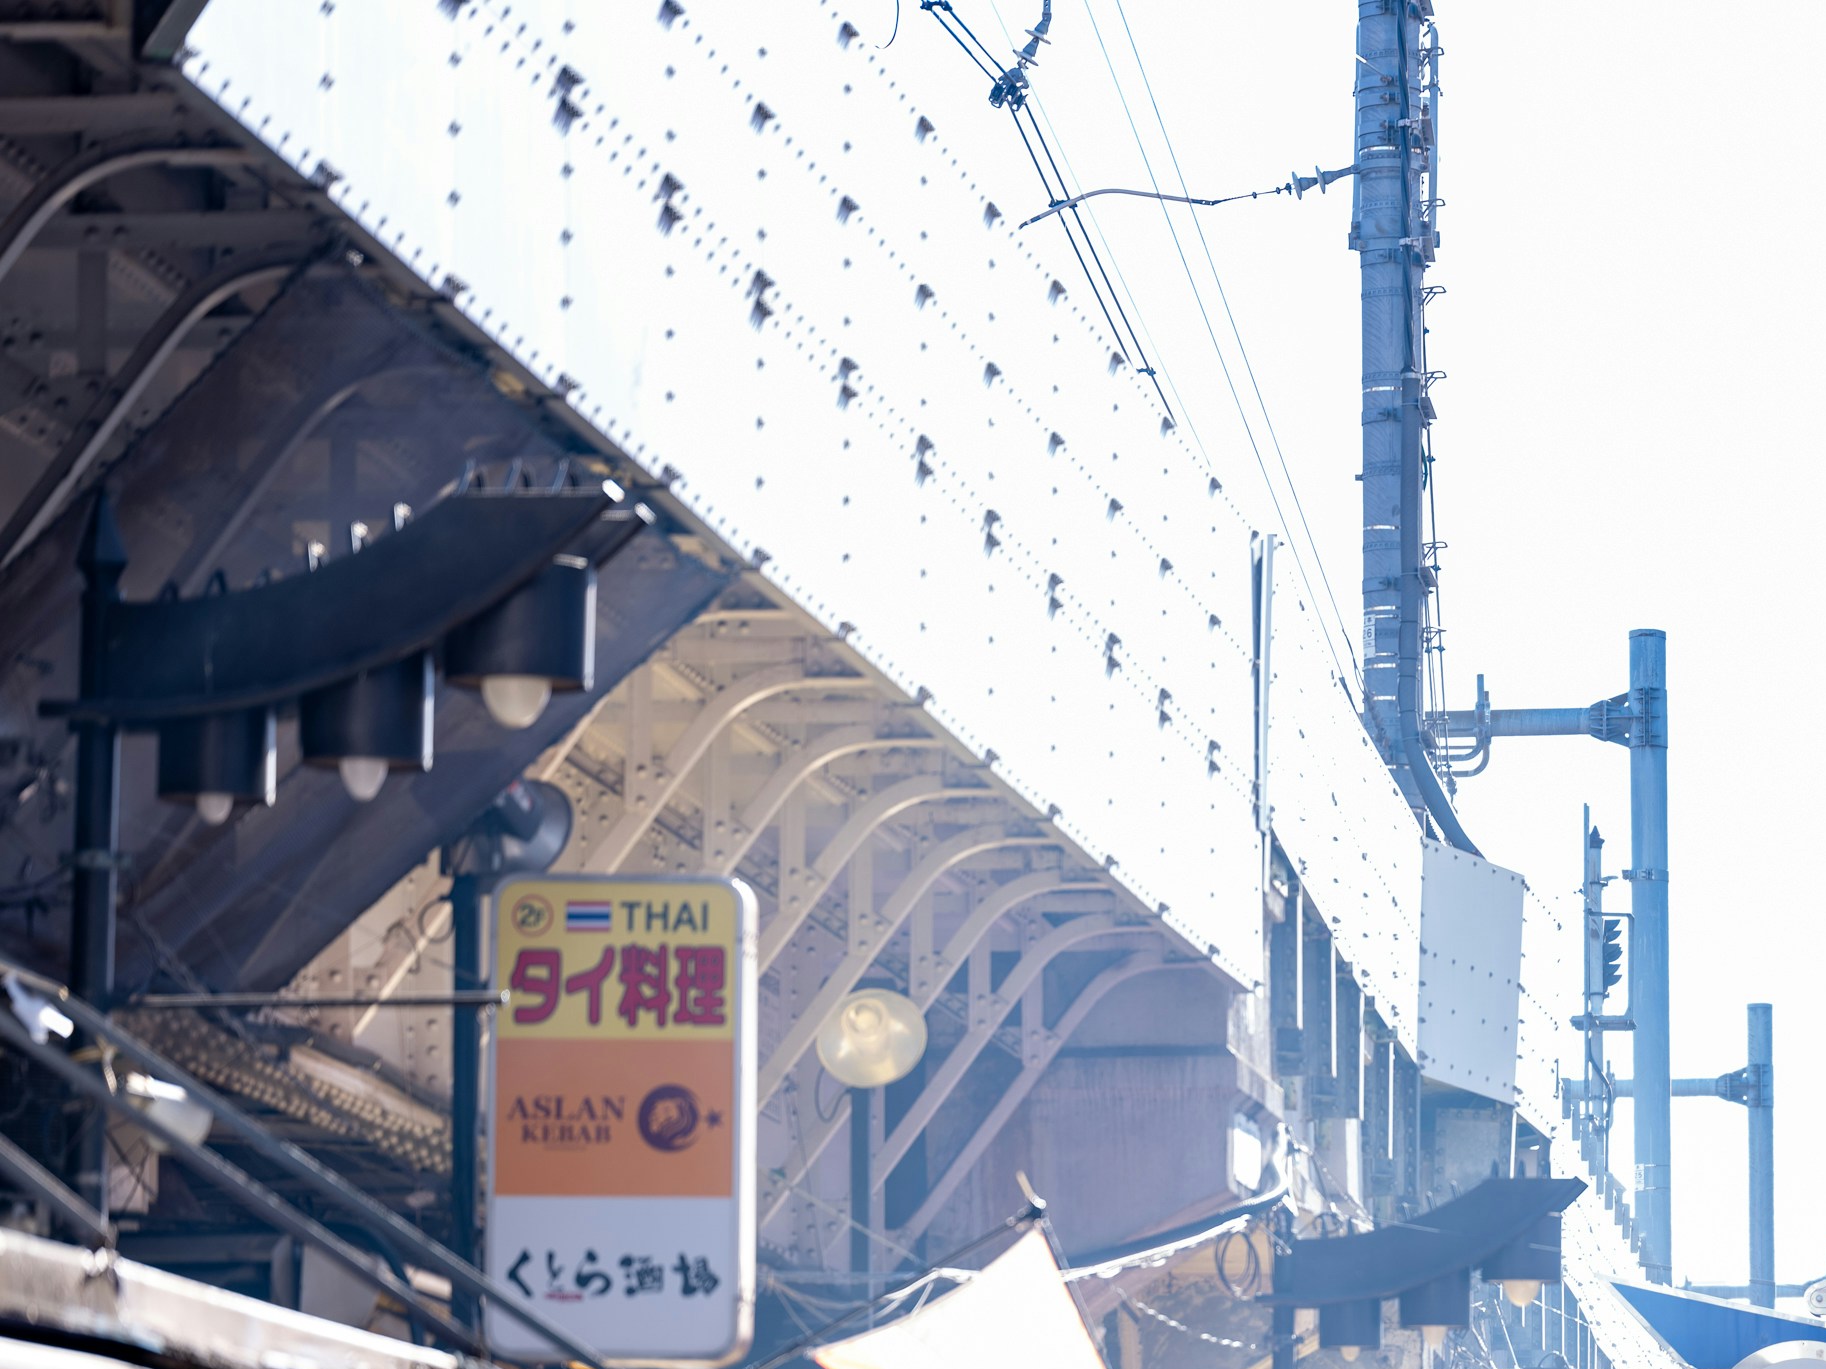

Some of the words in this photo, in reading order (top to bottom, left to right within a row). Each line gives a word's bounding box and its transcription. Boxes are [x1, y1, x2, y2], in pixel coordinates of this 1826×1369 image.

[518, 903, 545, 929] 2F
[620, 902, 709, 932] THAI
[509, 943, 727, 1028] タイ料理
[507, 1096, 626, 1121] ASLAN
[521, 1124, 612, 1144] KEBAB
